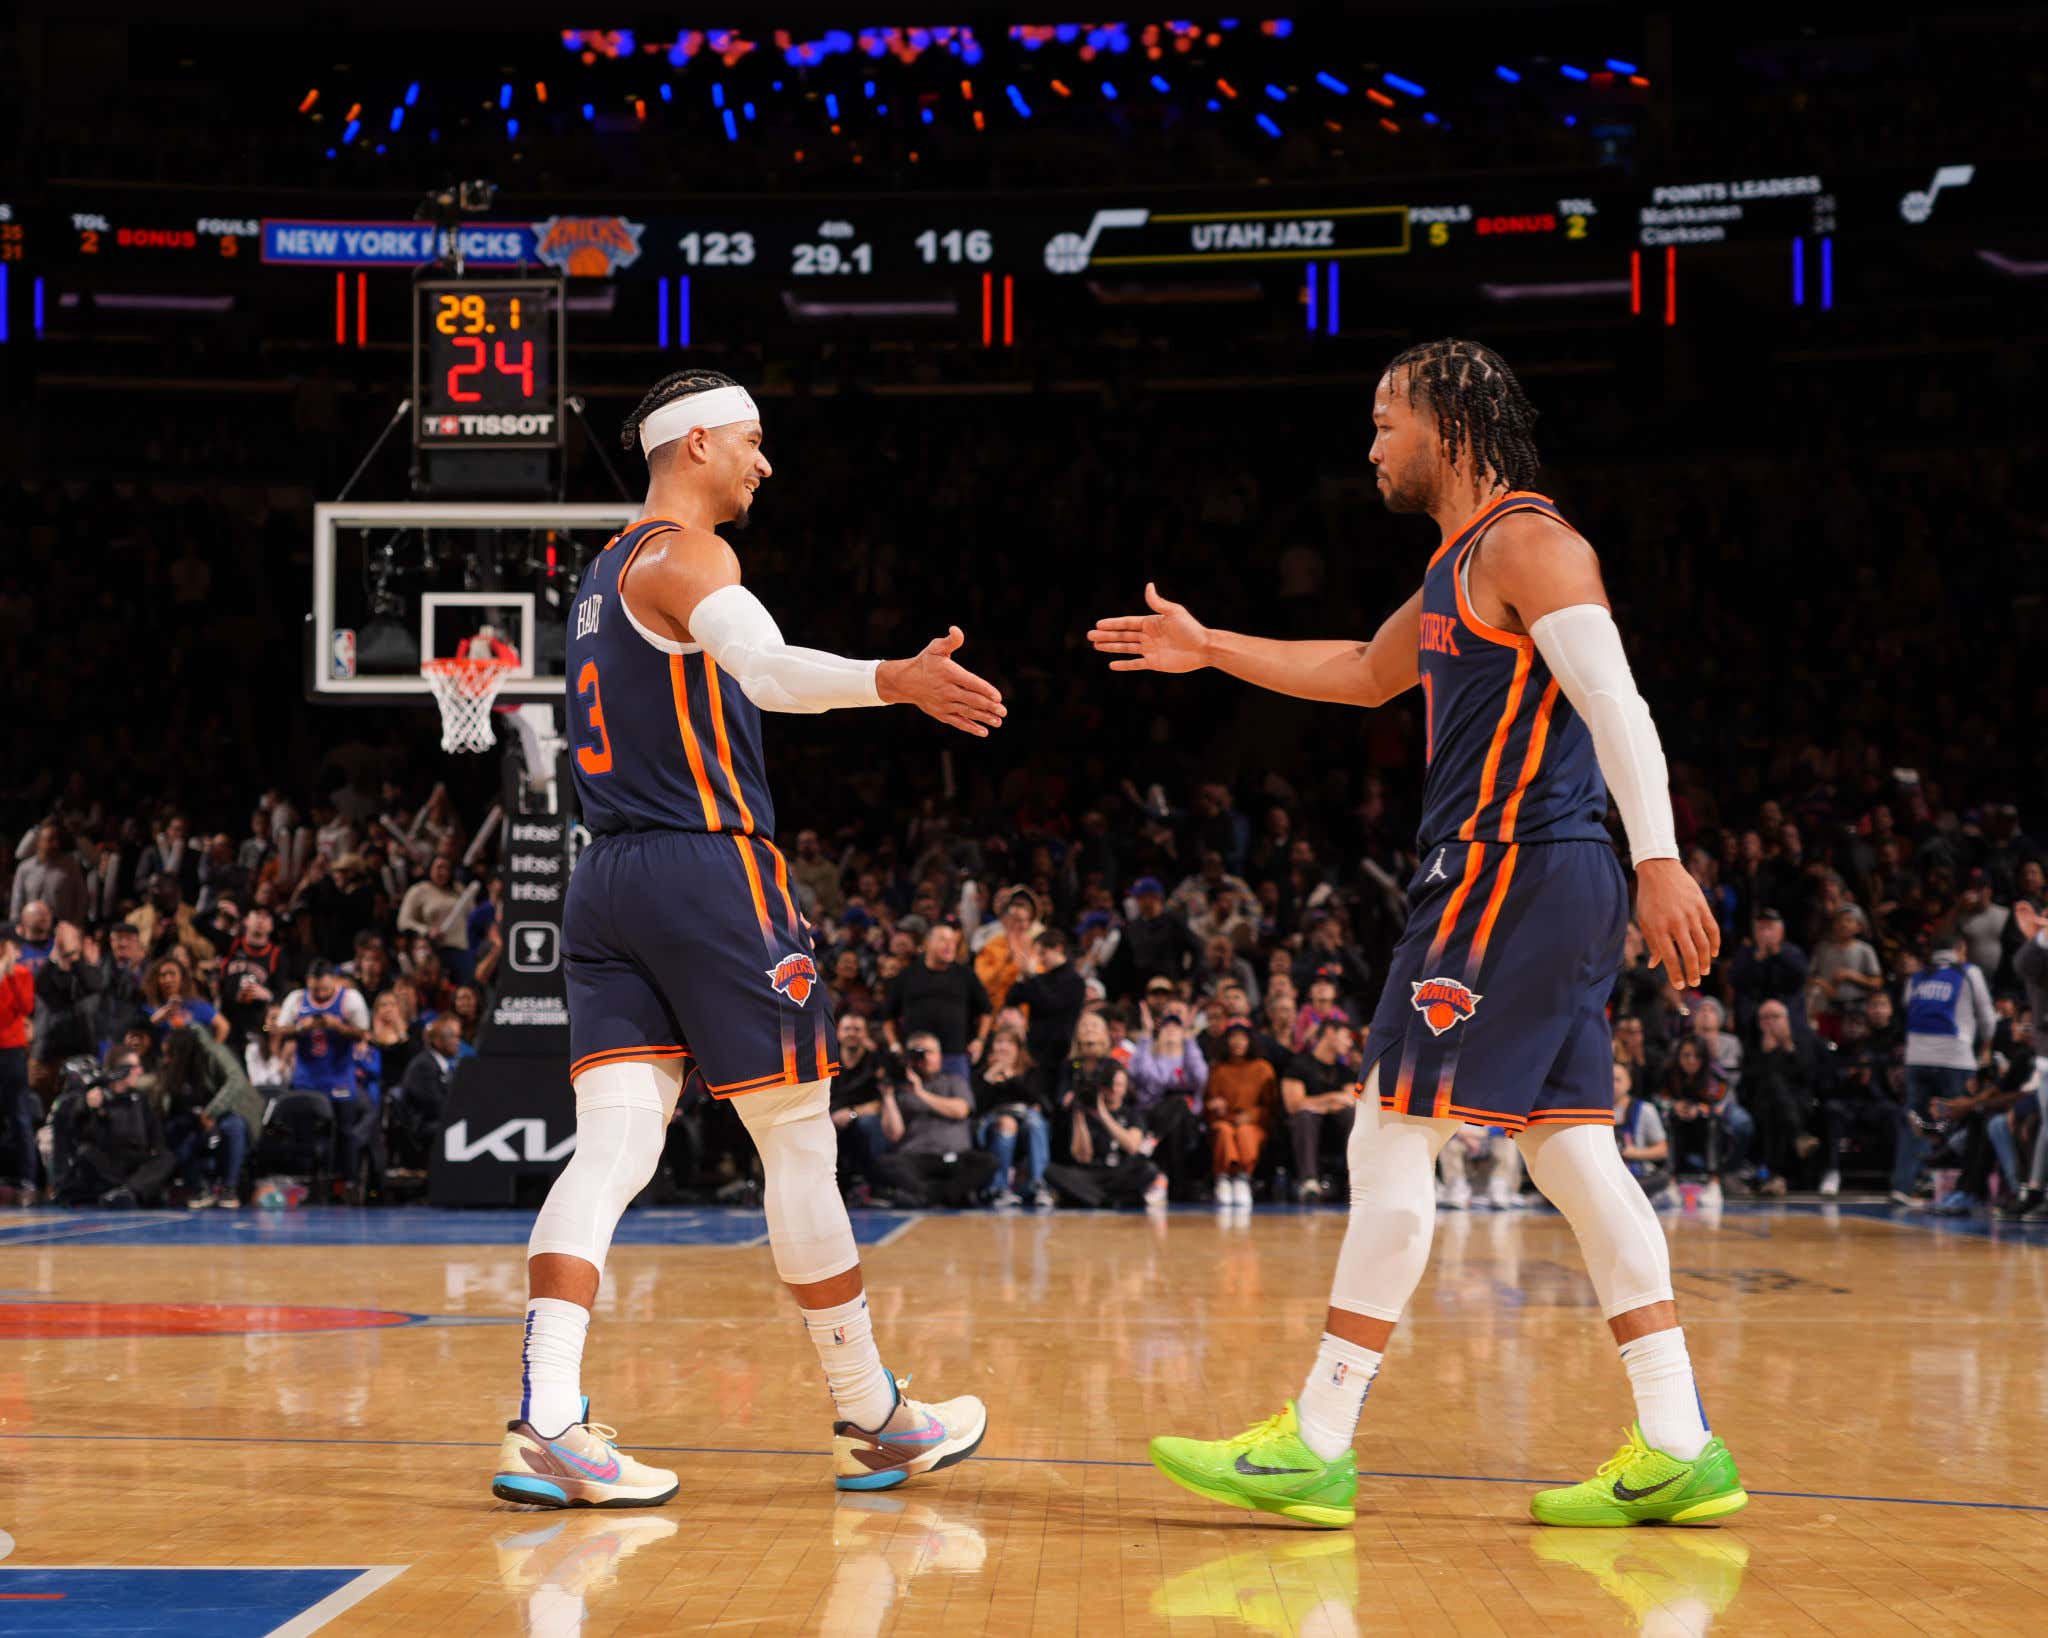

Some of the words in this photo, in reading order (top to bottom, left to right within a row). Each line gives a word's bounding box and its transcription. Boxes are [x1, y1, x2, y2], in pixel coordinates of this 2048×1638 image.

[1654, 184, 1726, 203] POINTS
[1730, 176, 1822, 200] LEADERS
[117, 228, 196, 249] BONUS
[197, 217, 259, 236] FOULS
[1191, 223, 1265, 250] UTAH
[1267, 220, 1334, 248] JAZZ
[1429, 223, 1449, 246] 5
[1476, 214, 1556, 236] BONUS
[1566, 216, 1588, 239] 2
[80, 231, 99, 253] 2
[219, 235, 238, 257] 5
[275, 229, 341, 256] NEW
[344, 230, 415, 257] YORK
[678, 231, 756, 265] 123
[915, 229, 993, 263] 116
[791, 243, 872, 275] 29.1
[436, 295, 521, 334] 29.1
[447, 336, 534, 402] 24
[459, 414, 554, 435] TISSOT
[576, 656, 614, 777] 3
